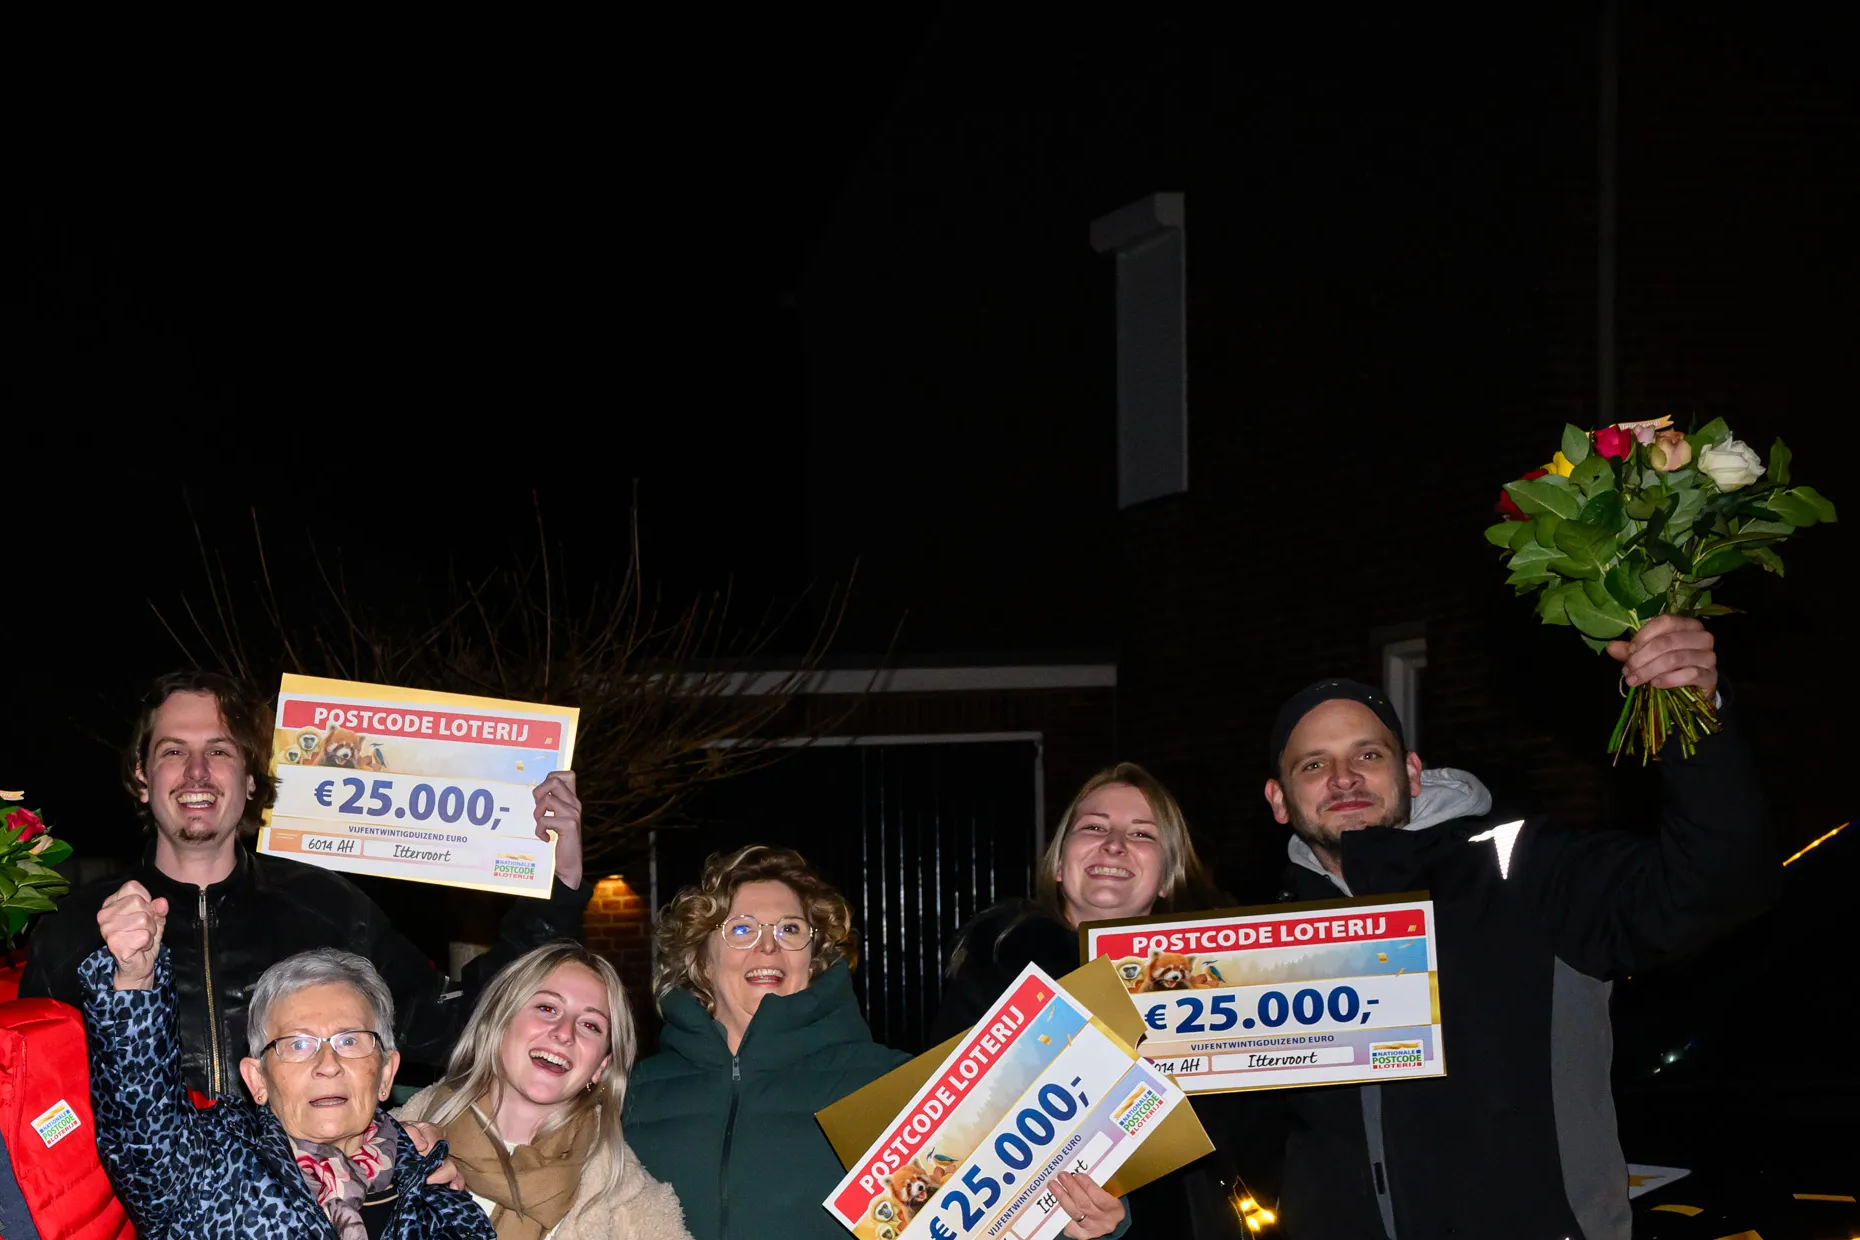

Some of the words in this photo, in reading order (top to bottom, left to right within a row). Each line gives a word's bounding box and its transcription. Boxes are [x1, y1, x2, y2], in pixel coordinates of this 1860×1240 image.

[314, 708, 434, 734] POSTCODE
[439, 717, 528, 742] LOTERIJ
[348, 825, 444, 842] VIJFENTWINTIGDUIZEND
[446, 834, 468, 843] EURO
[308, 838, 333, 852] 6014
[337, 840, 355, 854] AH
[393, 844, 451, 863] Ittervoort
[494, 865, 535, 875] POSTCODE
[498, 872, 530, 880] LOTERIJ
[1133, 922, 1273, 953] POSTCODE
[1280, 917, 1386, 943] LOTERIJ
[1190, 1037, 1306, 1052] VIJFENTWINTIGDUIZEND
[1308, 1035, 1334, 1043] EURO
[1154, 1062, 1175, 1074] 014
[1180, 1058, 1200, 1072] AH
[1248, 1053, 1318, 1068] Ittervoort
[1372, 1054, 1422, 1064] POSTCODE
[859, 1086, 957, 1195] POSTCODE
[948, 1005, 1025, 1098] LOTERIJ
[1123, 1094, 1148, 1122] NATIONALE
[42, 1111, 67, 1131] NATIONALE
[1123, 1094, 1159, 1132] POSTCODE
[1134, 1103, 1159, 1131] LOTERIJ
[42, 1113, 75, 1140] POSTCODE
[50, 1123, 74, 1143] LOTERIJ
[988, 1154, 1064, 1237] VIJFENTWINTIGDUIZEND
[1062, 1134, 1082, 1156] EURO
